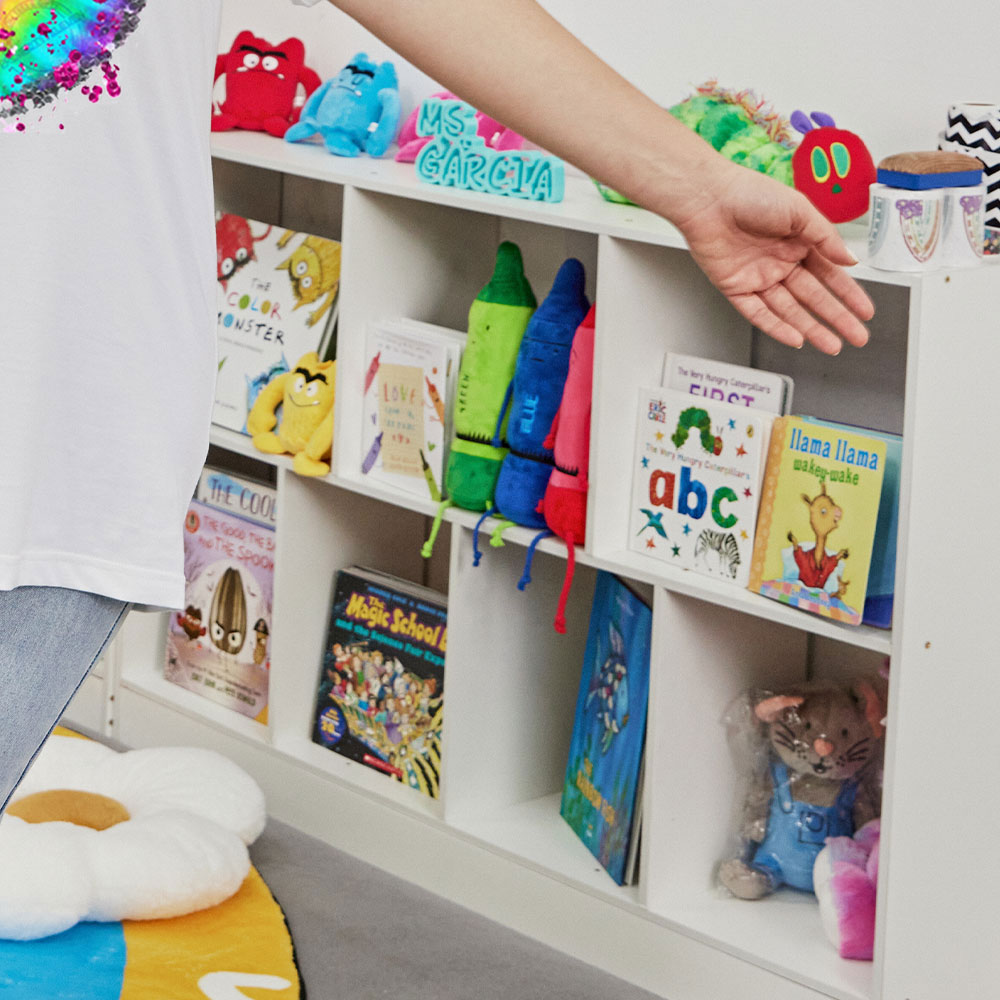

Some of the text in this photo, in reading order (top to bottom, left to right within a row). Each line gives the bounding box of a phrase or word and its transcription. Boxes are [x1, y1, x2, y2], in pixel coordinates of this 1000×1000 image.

[419, 144, 553, 199] GARCIA
[251, 278, 272, 292] THE
[227, 291, 282, 320] COLOR
[384, 380, 416, 404] LOVE
[678, 366, 772, 394] The Very Hungry Caterpillar's
[789, 427, 879, 471] llama llama
[793, 458, 860, 486] wakey-wake
[210, 478, 233, 505] THE
[648, 466, 739, 529] abc
[221, 521, 247, 540] GOOD
[215, 536, 235, 558] THE
[368, 595, 385, 609] The
[345, 592, 391, 628] Magic
[390, 608, 441, 647] School
